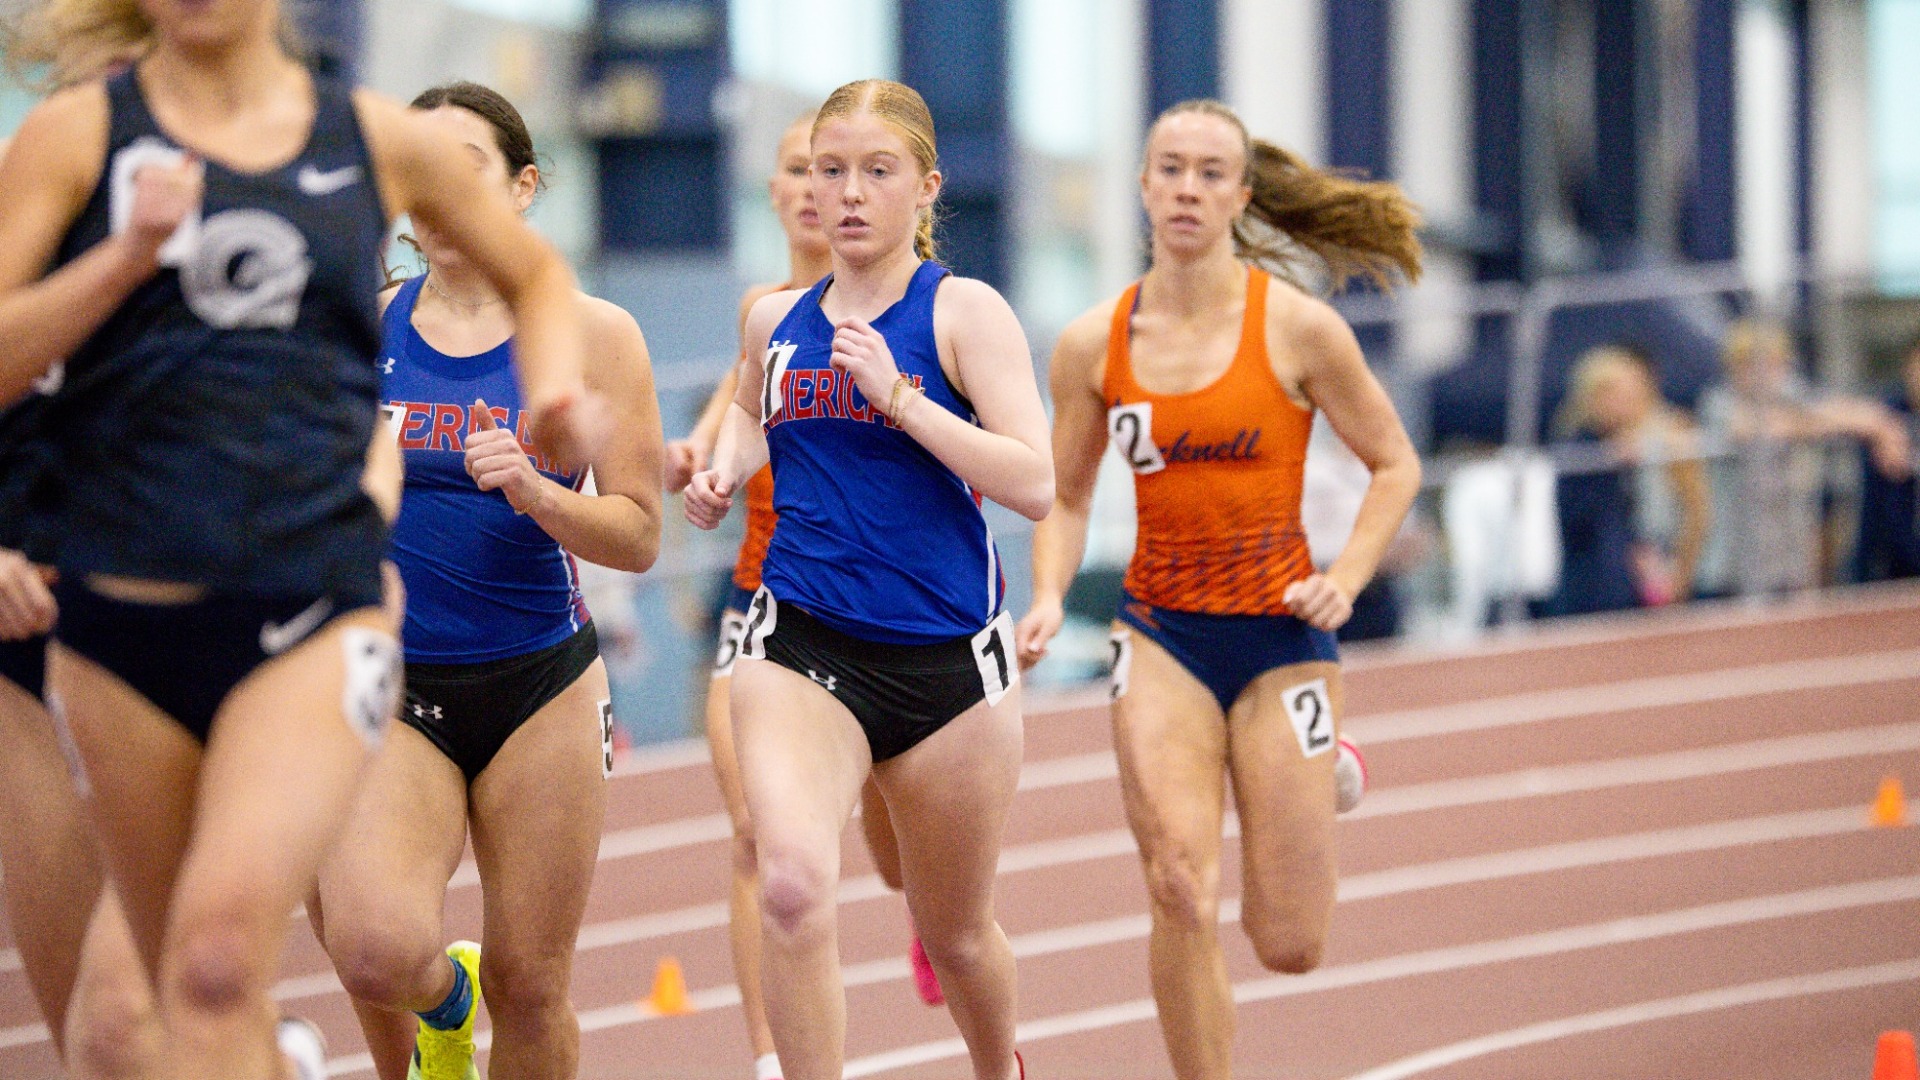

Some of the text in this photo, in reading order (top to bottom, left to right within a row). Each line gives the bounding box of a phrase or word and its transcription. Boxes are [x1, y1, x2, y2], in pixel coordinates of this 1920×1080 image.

[763, 368, 924, 436] MERIC
[1115, 413, 1155, 467] 2
[1159, 427, 1261, 463] knell
[981, 626, 1010, 691] 1
[1294, 689, 1330, 749] 2
